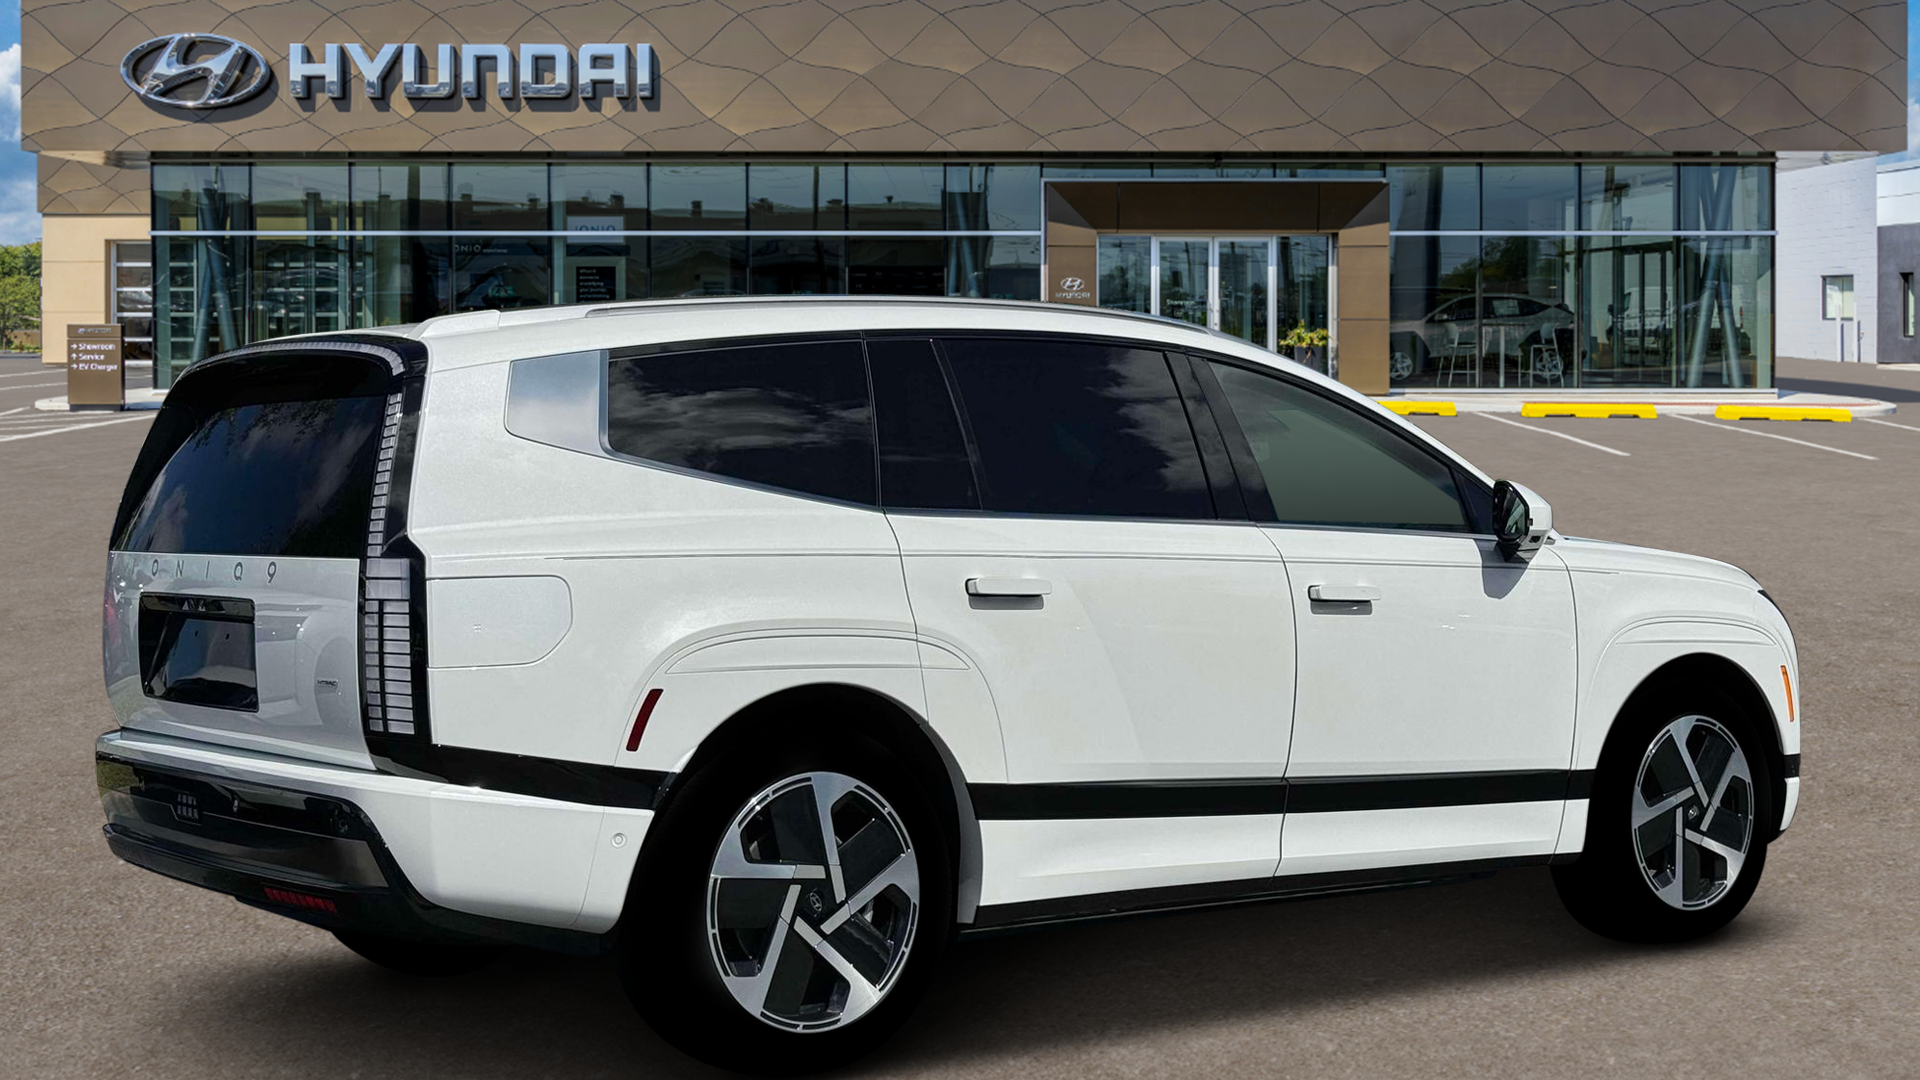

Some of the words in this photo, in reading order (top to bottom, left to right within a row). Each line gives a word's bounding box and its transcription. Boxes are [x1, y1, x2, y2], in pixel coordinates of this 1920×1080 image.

[289, 43, 653, 99] HYUNDAI
[78, 343, 116, 351] Showroom
[78, 352, 105, 360] Service
[90, 363, 118, 372] Charger
